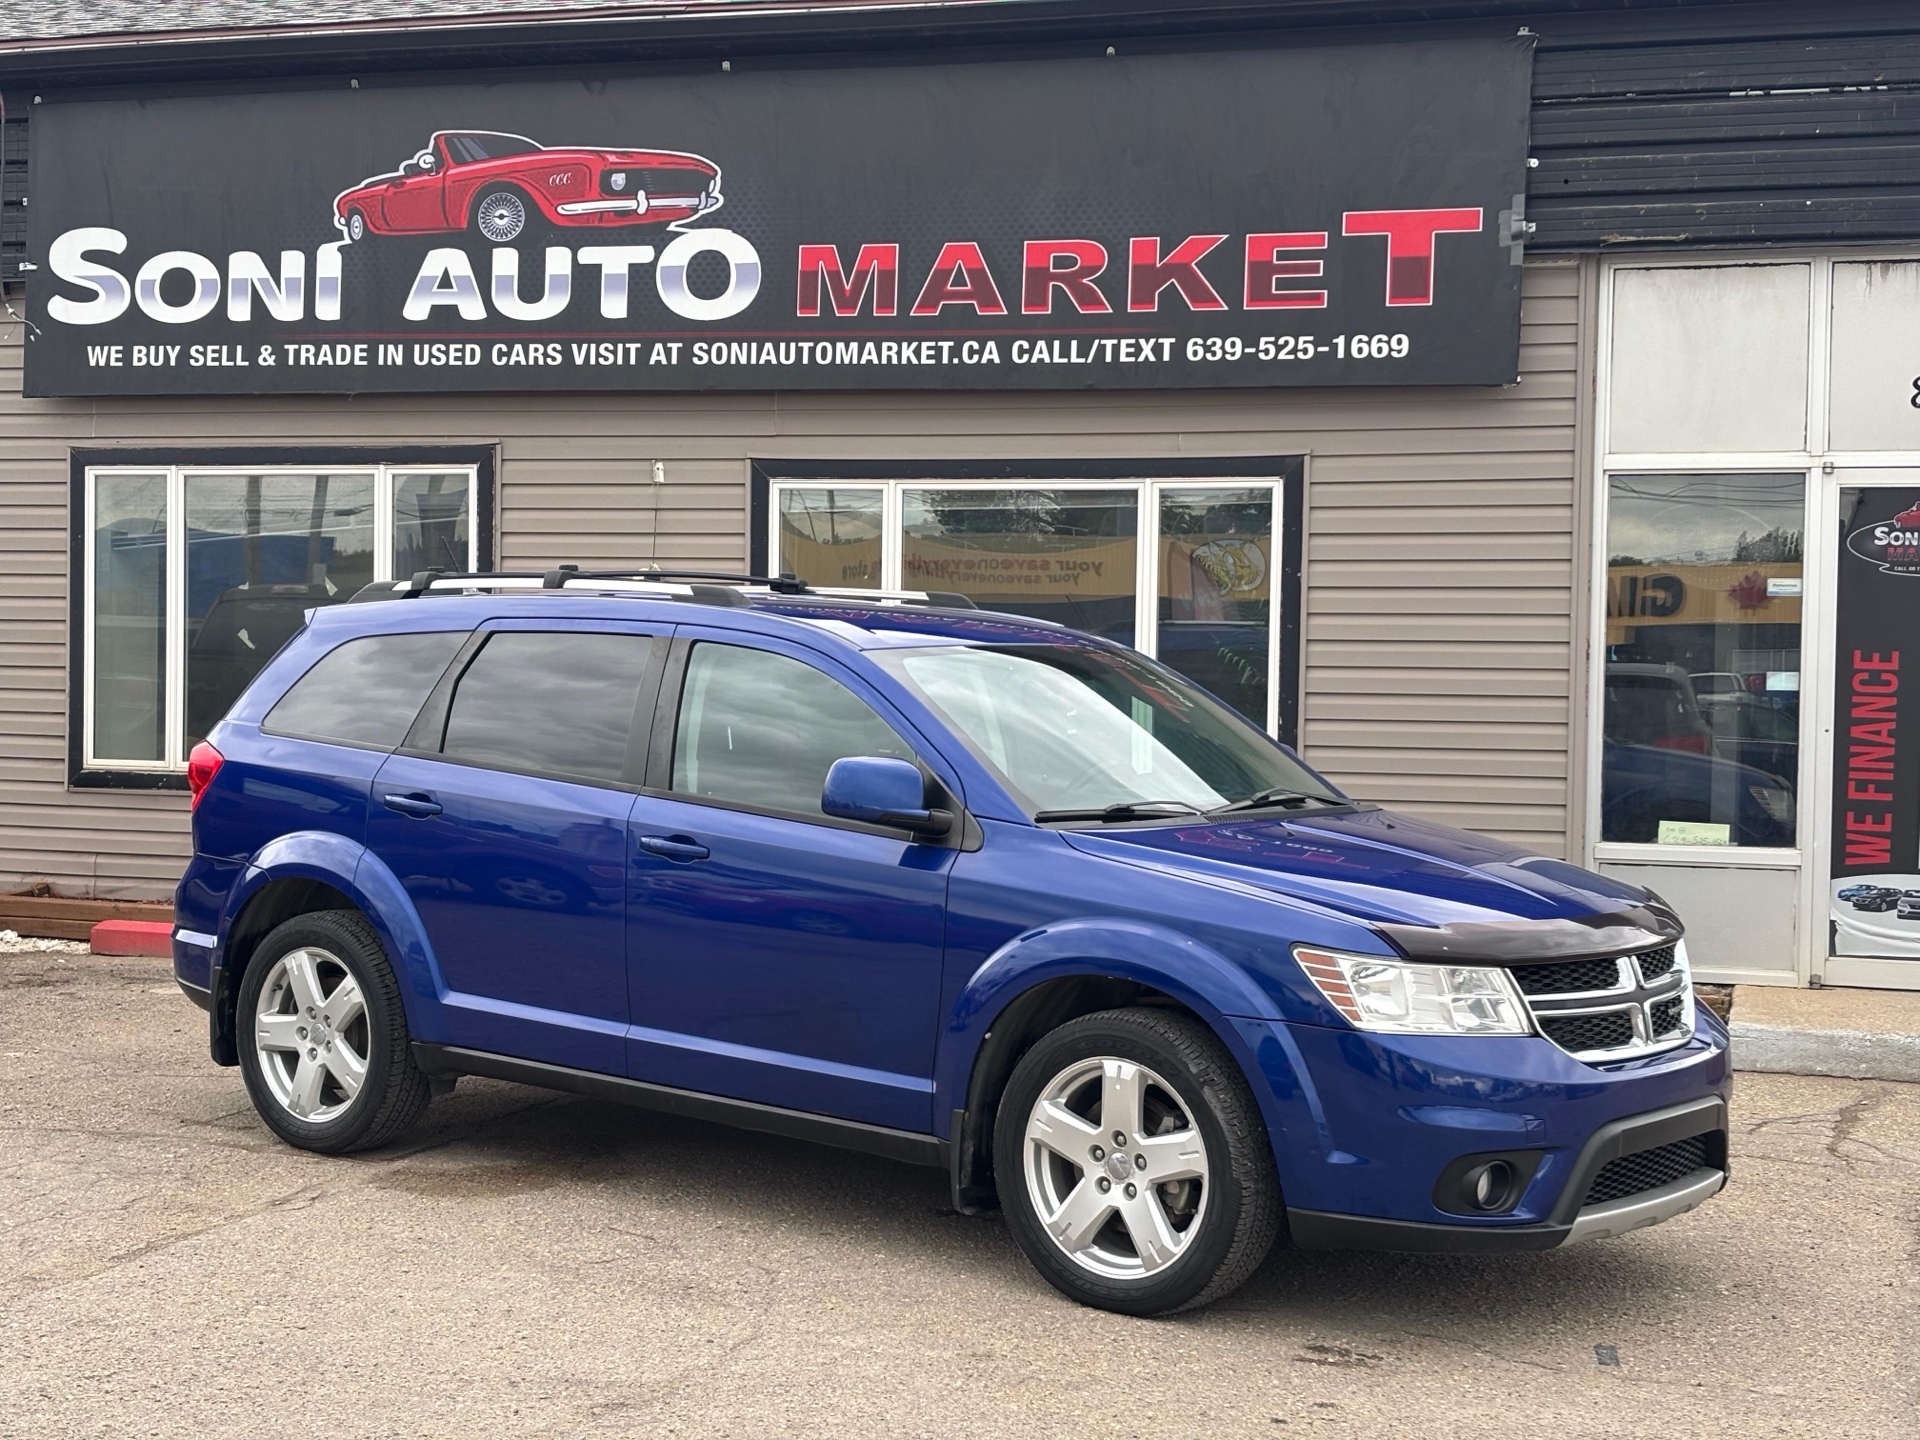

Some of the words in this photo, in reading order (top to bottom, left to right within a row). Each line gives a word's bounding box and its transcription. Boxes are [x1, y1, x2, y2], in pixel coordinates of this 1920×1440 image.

[47, 227, 344, 325] SONI
[402, 228, 762, 321] AUTO
[796, 206, 1484, 317] MARKET
[86, 345, 124, 367] WE
[132, 345, 182, 367] BUY
[189, 344, 250, 367] SELL
[257, 344, 276, 367] &
[283, 343, 369, 366] TRADE
[377, 343, 404, 366] IN
[413, 343, 482, 366] USED
[491, 343, 563, 366] CARS
[570, 342, 642, 366] VISIT
[648, 342, 684, 366] AT
[691, 340, 1001, 366] SONIAUTOMARKET.CA
[1011, 337, 1176, 364] CALL/TEXT
[1186, 333, 1410, 362] 639-525-1669
[1847, 650, 1899, 801] FINANCE
[1845, 811, 1892, 865] WE
